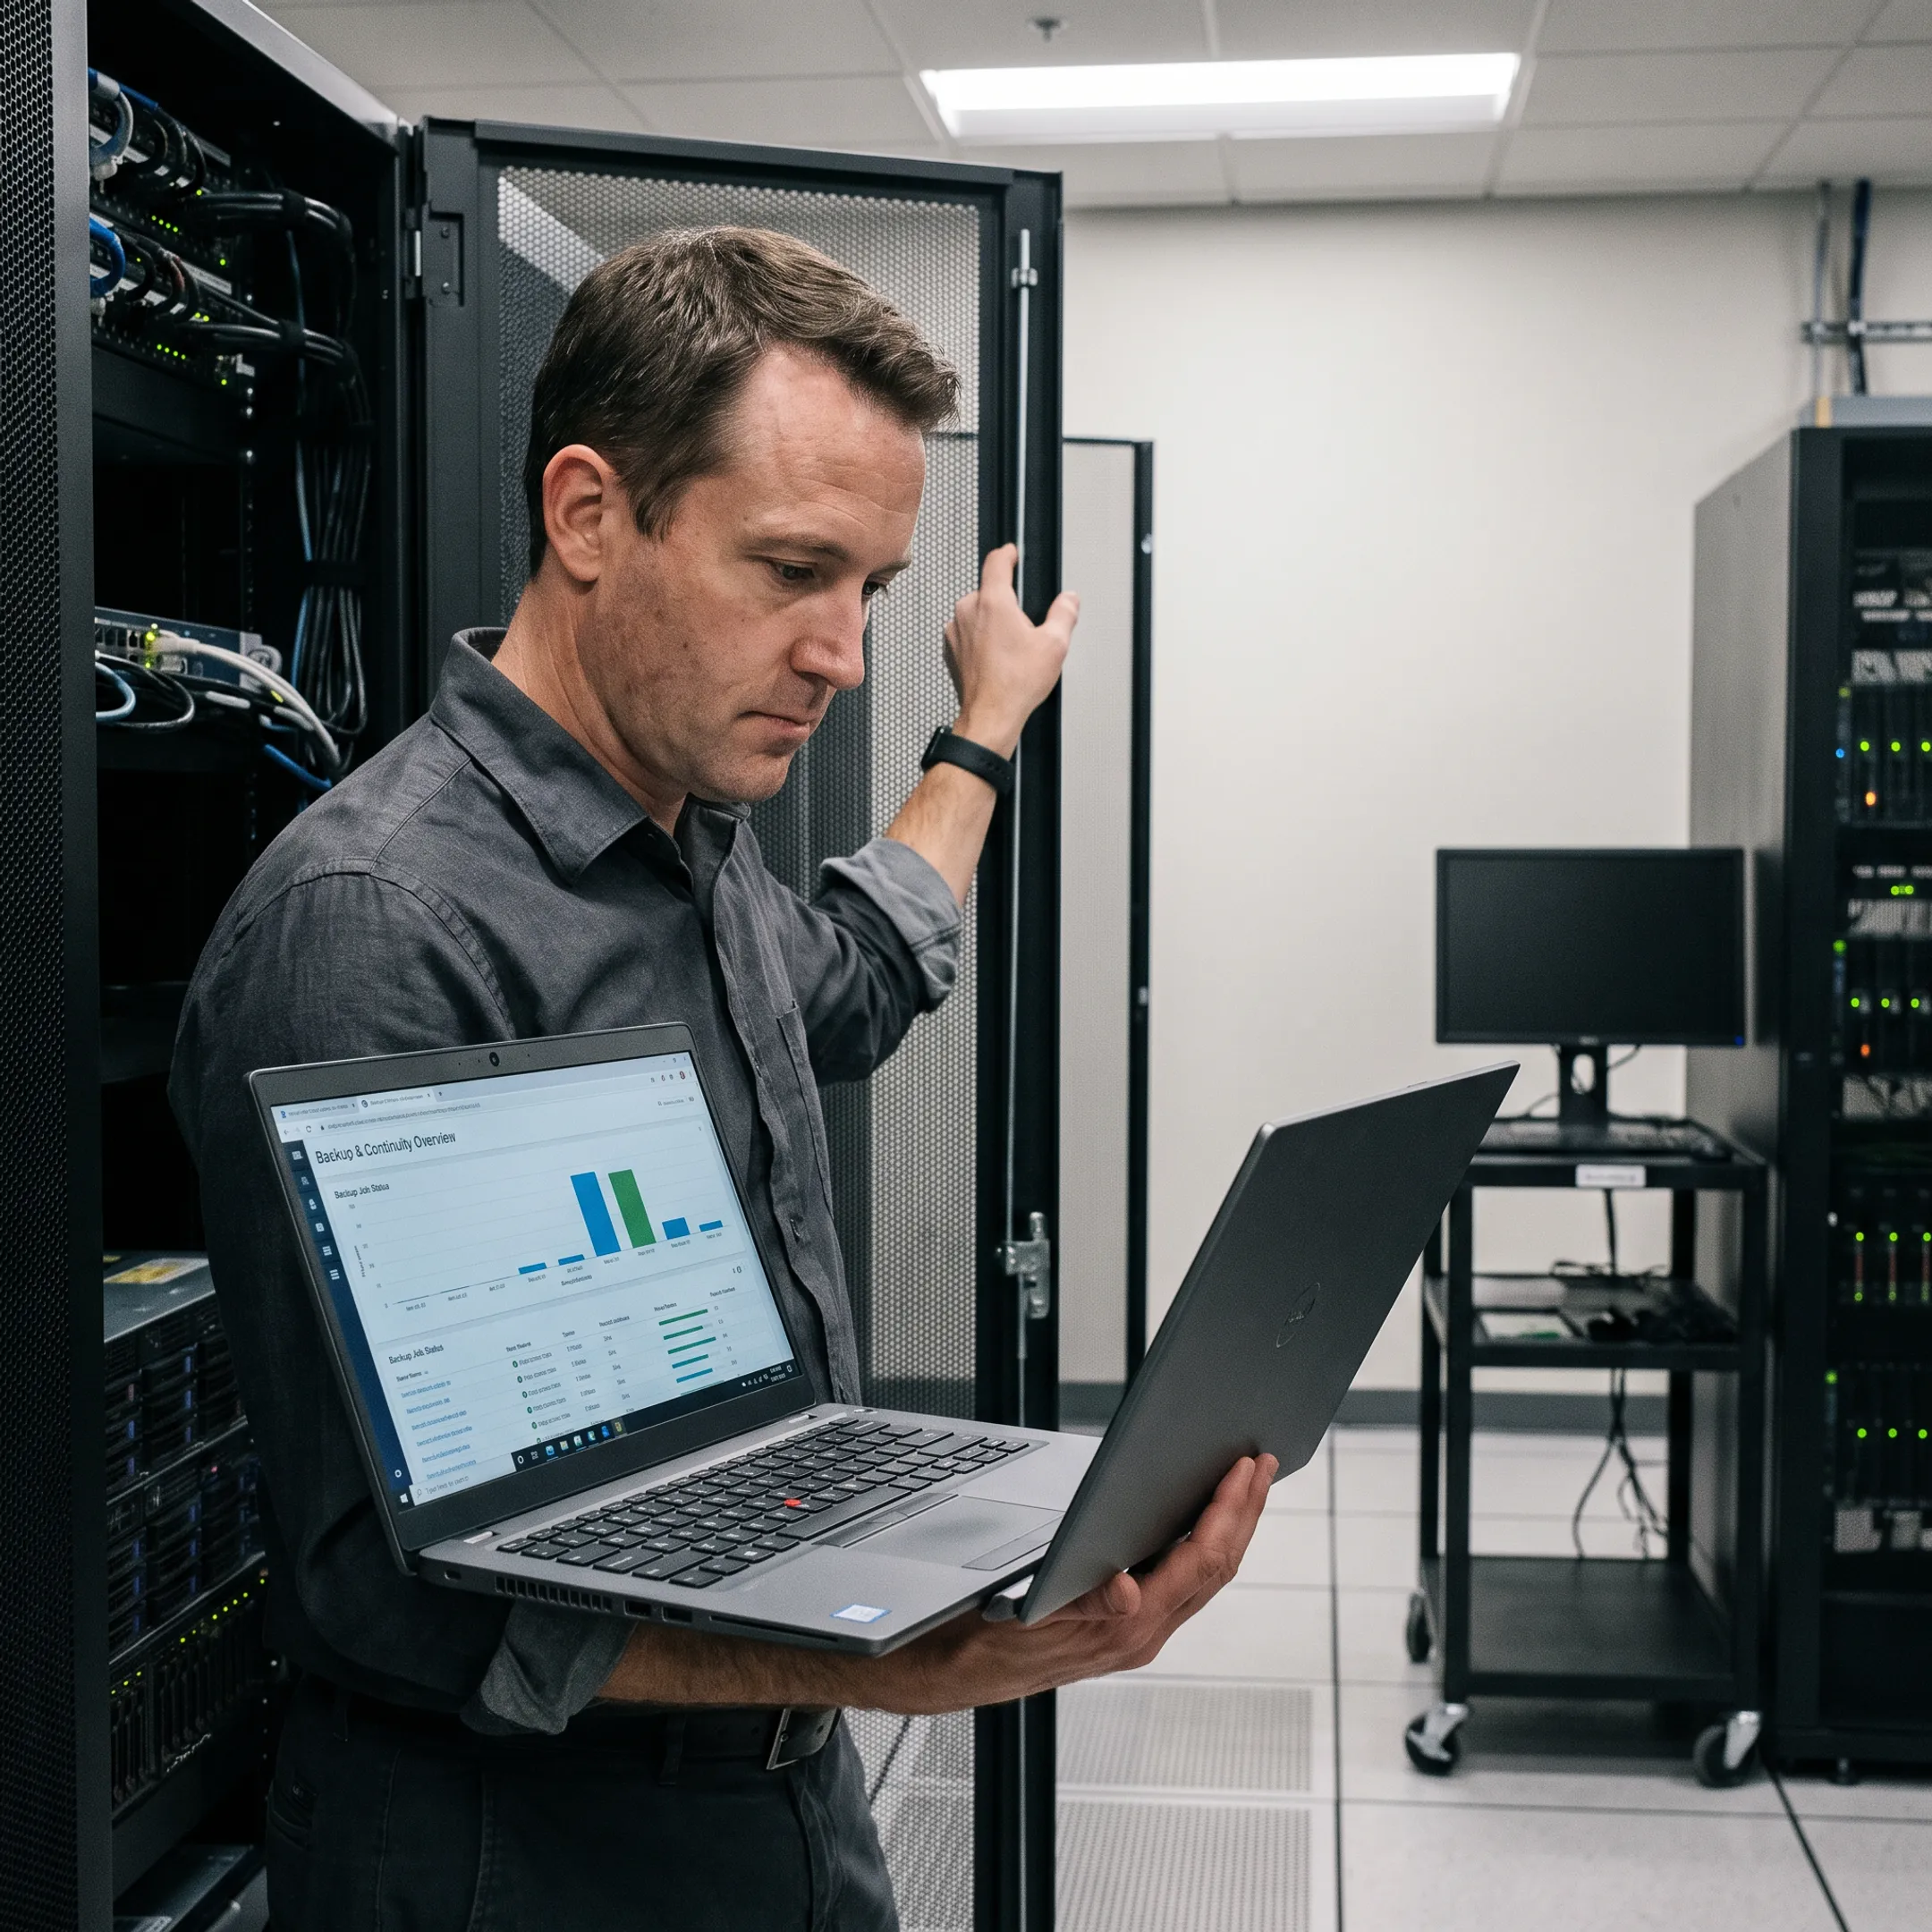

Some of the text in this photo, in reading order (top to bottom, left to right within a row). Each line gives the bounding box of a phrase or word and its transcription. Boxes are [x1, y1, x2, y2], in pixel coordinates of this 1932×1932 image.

[315, 1131, 456, 1164] Backup & Continuity Overview
